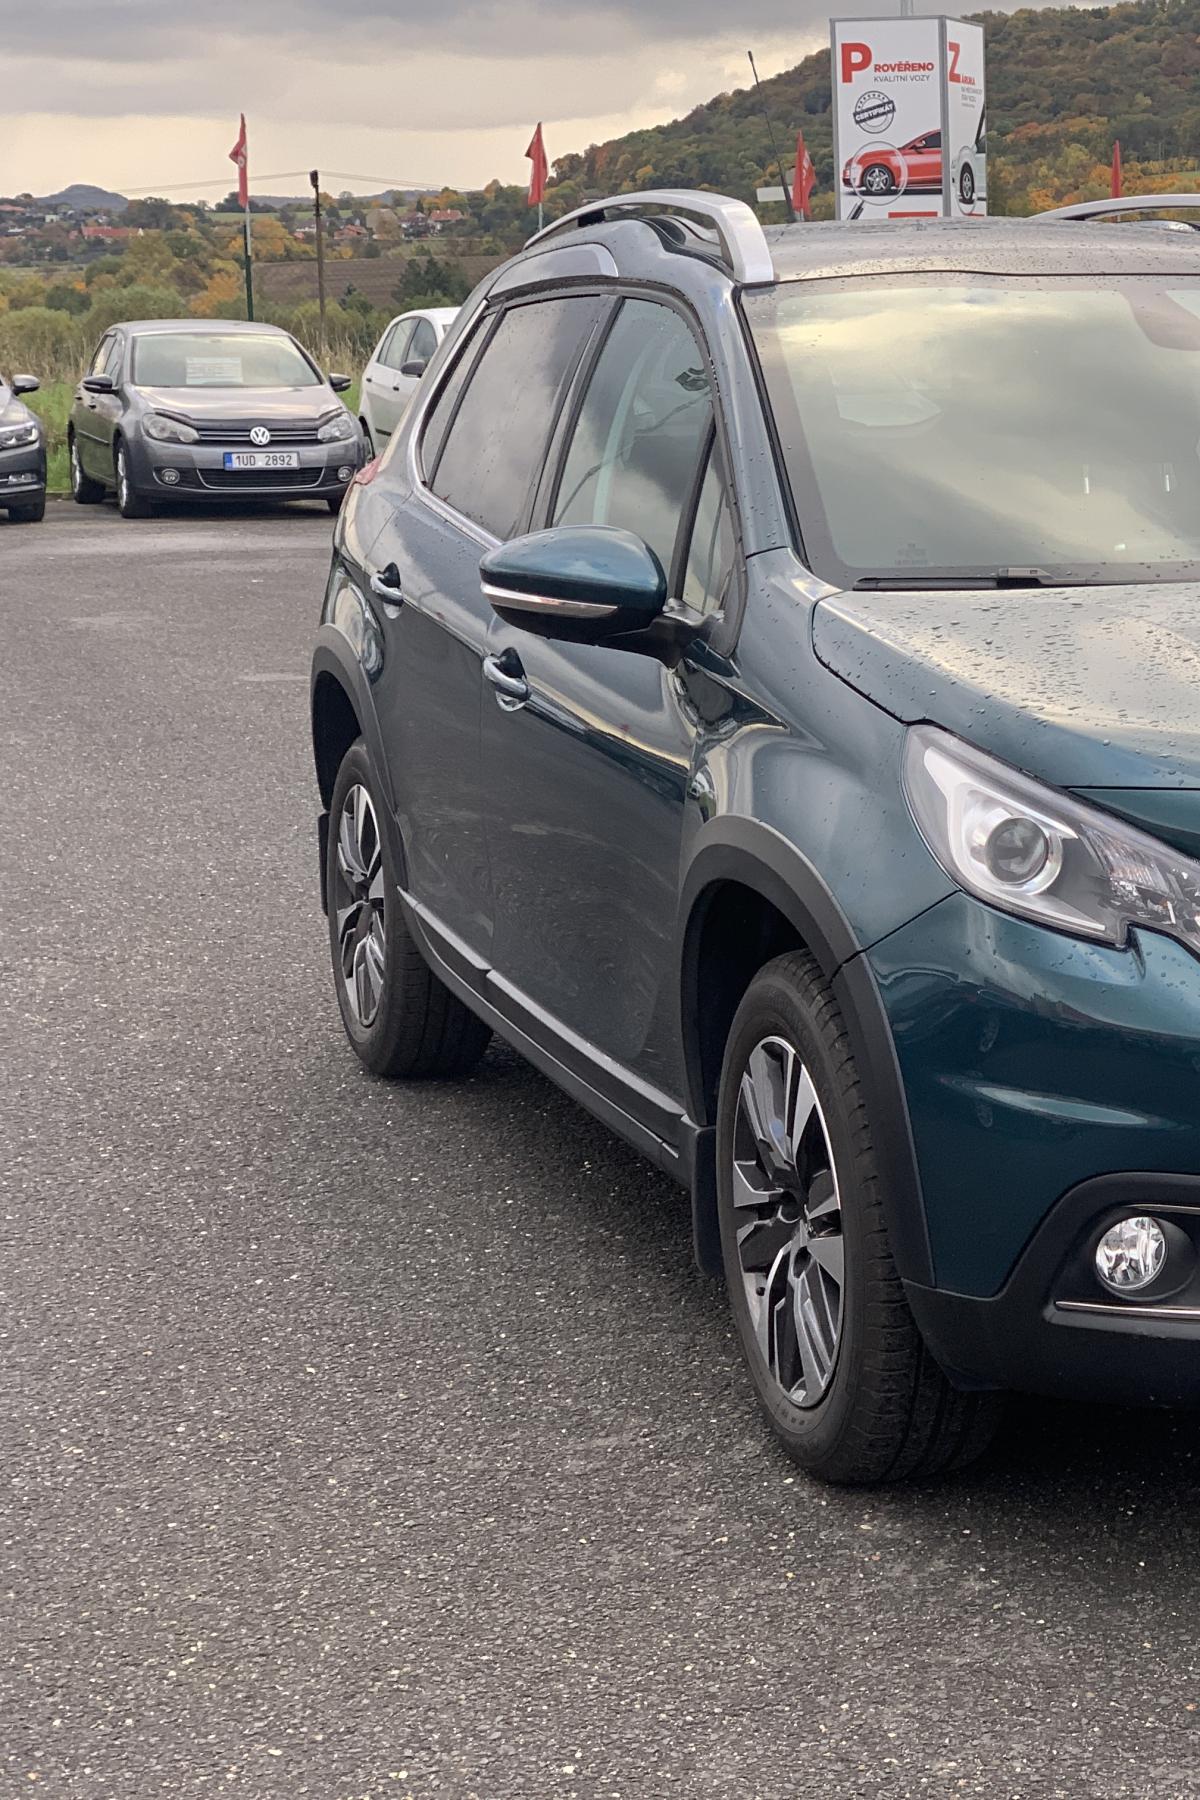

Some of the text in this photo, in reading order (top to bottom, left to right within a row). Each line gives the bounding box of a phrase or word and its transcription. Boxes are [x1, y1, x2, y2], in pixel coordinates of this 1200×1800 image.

[874, 74, 930, 82] KVALITNÍ VOZY
[235, 455, 292, 466] 1UD 2892
